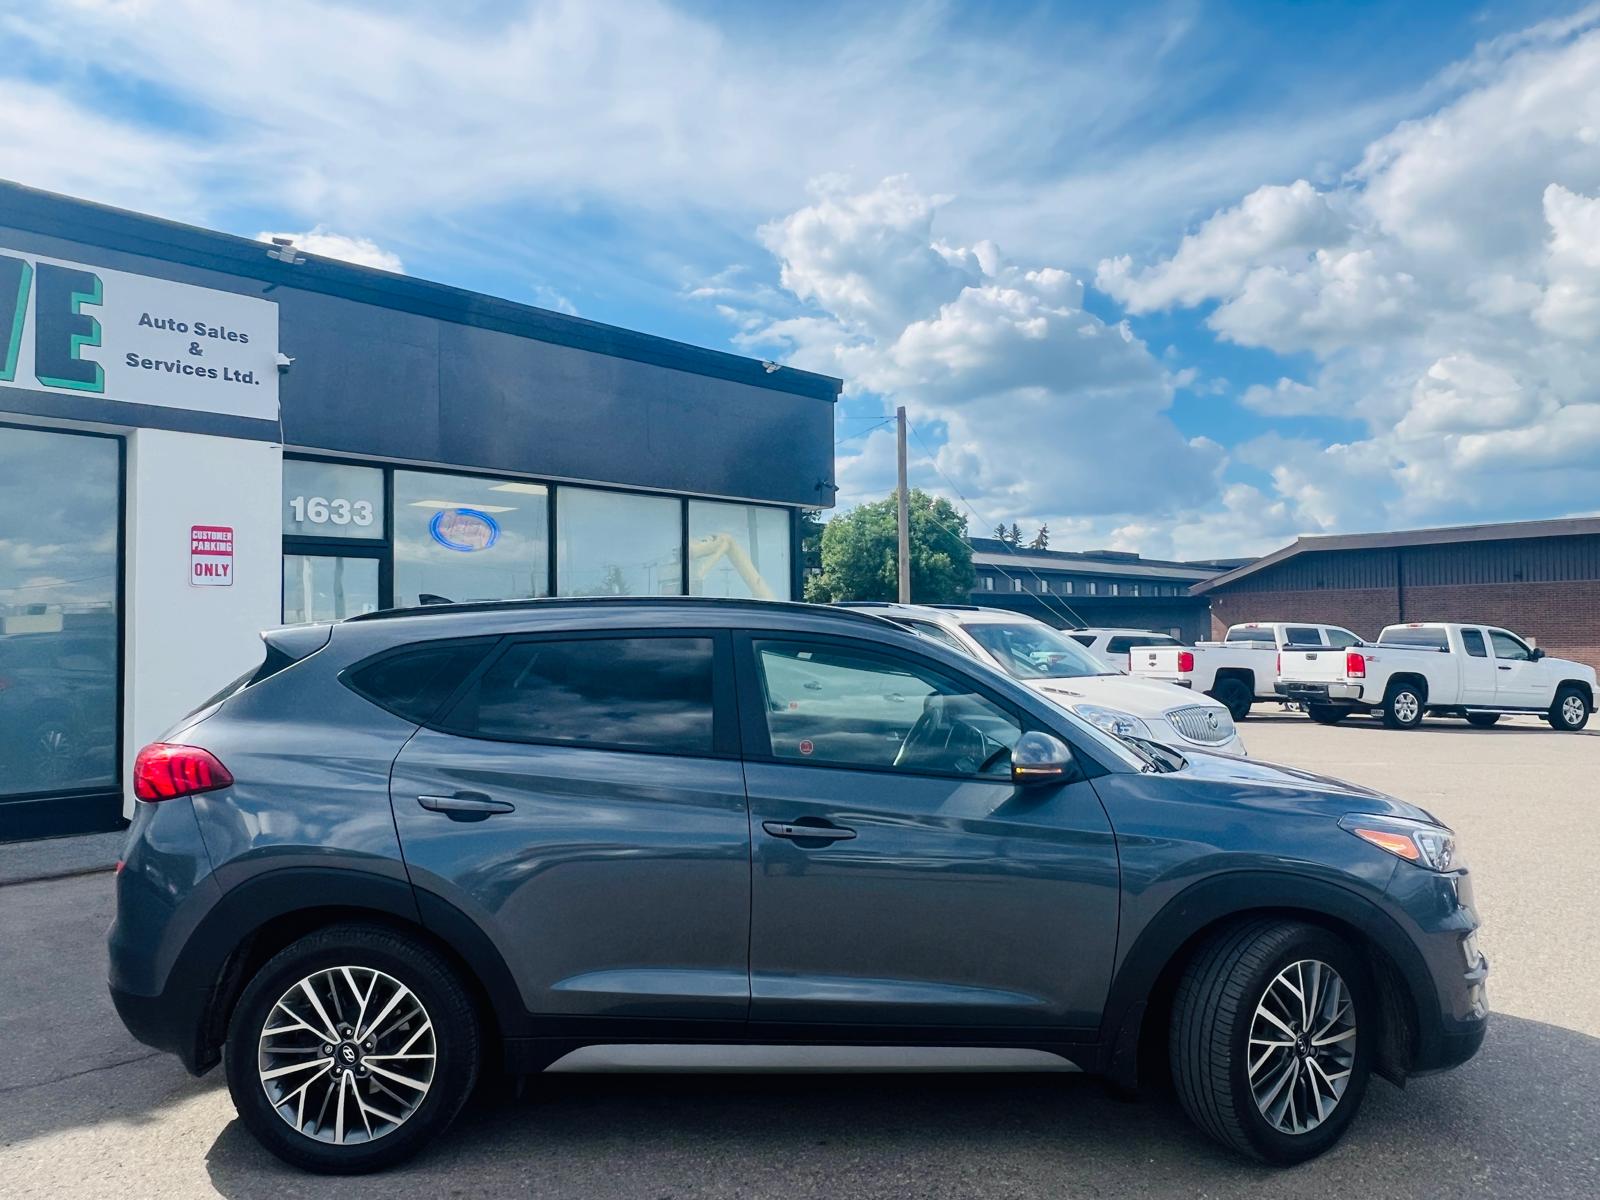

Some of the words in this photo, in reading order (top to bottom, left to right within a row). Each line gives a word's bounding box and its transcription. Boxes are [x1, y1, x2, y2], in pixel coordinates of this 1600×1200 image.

[138, 312, 189, 334] Auto
[193, 321, 249, 344] Sales
[188, 341, 204, 357] &
[125, 352, 218, 379] Services
[223, 366, 260, 386] Ltd.
[289, 495, 374, 526] 1633
[192, 530, 232, 541] CUSTOMER
[192, 540, 232, 552] PARKING
[194, 562, 230, 577] ONLY
